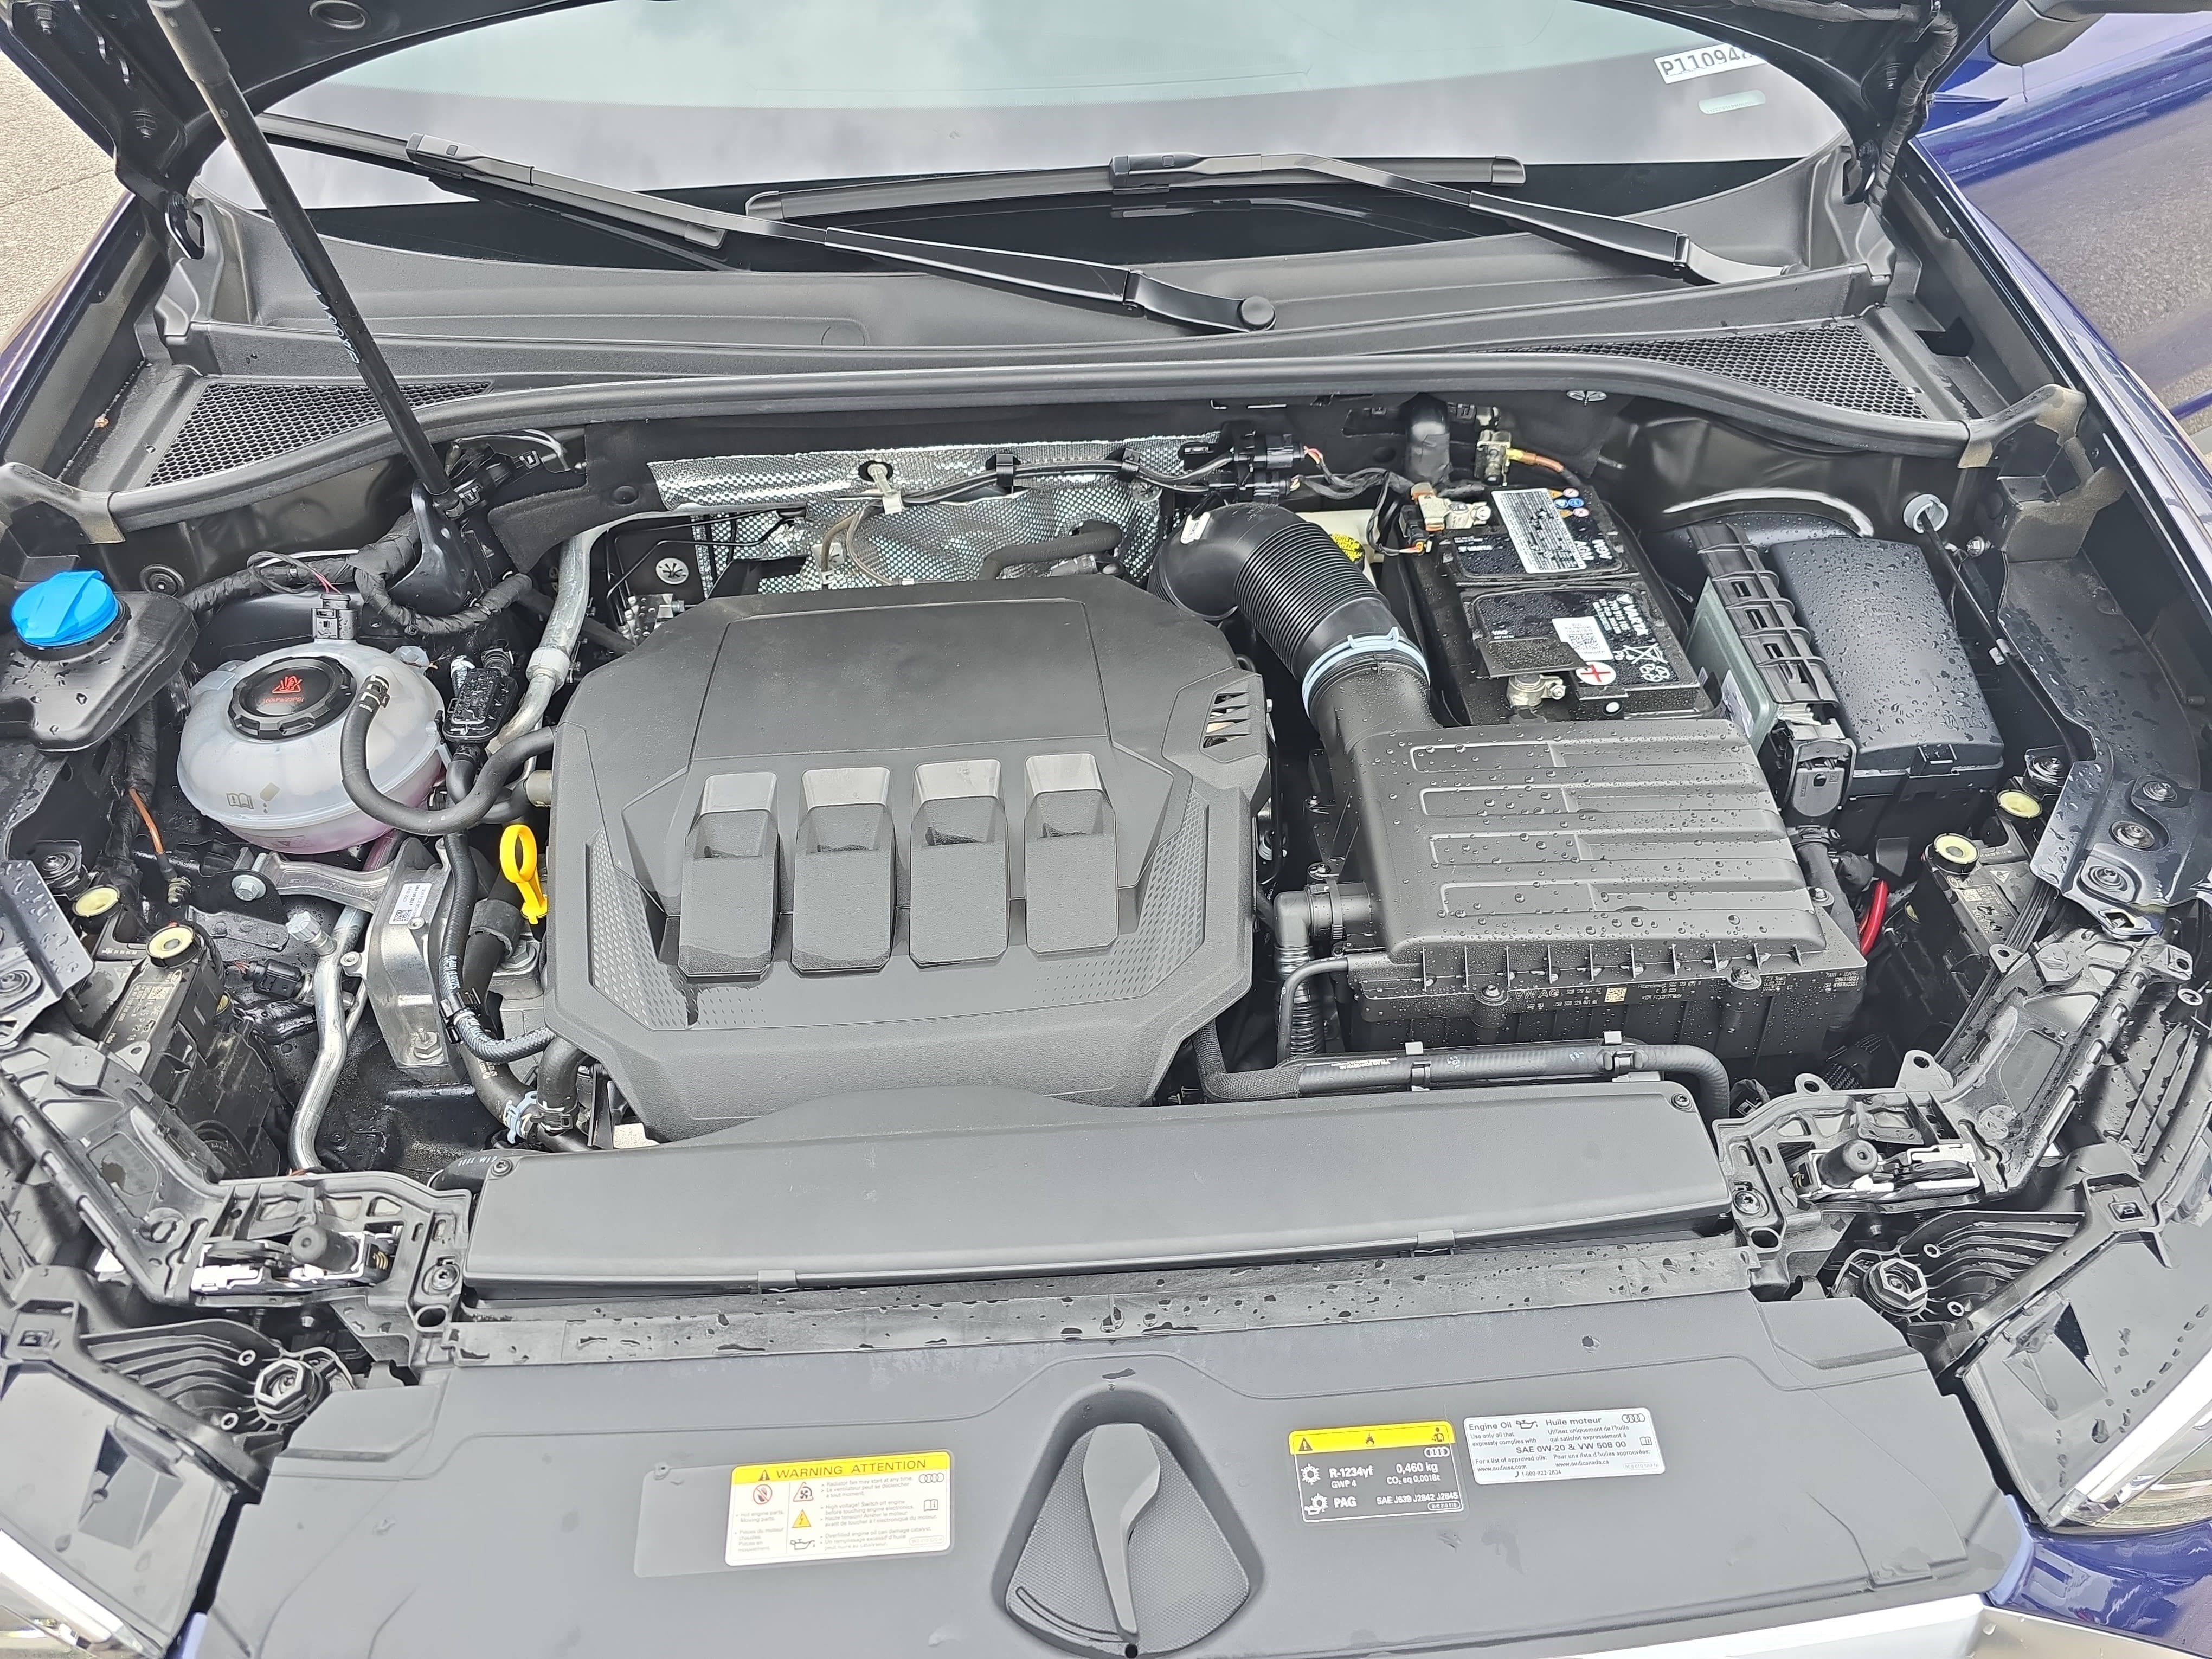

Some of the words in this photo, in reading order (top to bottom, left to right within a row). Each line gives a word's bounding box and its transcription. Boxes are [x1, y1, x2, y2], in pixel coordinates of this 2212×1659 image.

[1574, 540, 1595, 561] AGM
[1623, 604, 1649, 636] VARTA
[1538, 989, 1559, 998] AG
[1537, 1444, 1565, 1453] 0W-20
[776, 1465, 843, 1478] WARNING
[851, 1459, 926, 1473] ATTENTION
[1329, 1465, 1373, 1478] R-1234yf
[1396, 1462, 1424, 1474] 0,460
[1426, 1462, 1439, 1472] kg
[1331, 1480, 1350, 1489] GWP
[1351, 1479, 1357, 1487] 4
[1334, 1496, 1357, 1508] PAG
[1377, 1496, 1393, 1505] SAE
[1394, 1495, 1412, 1503] J639
[1413, 1494, 1436, 1502] J2842
[1436, 1491, 1459, 1501] J2845
